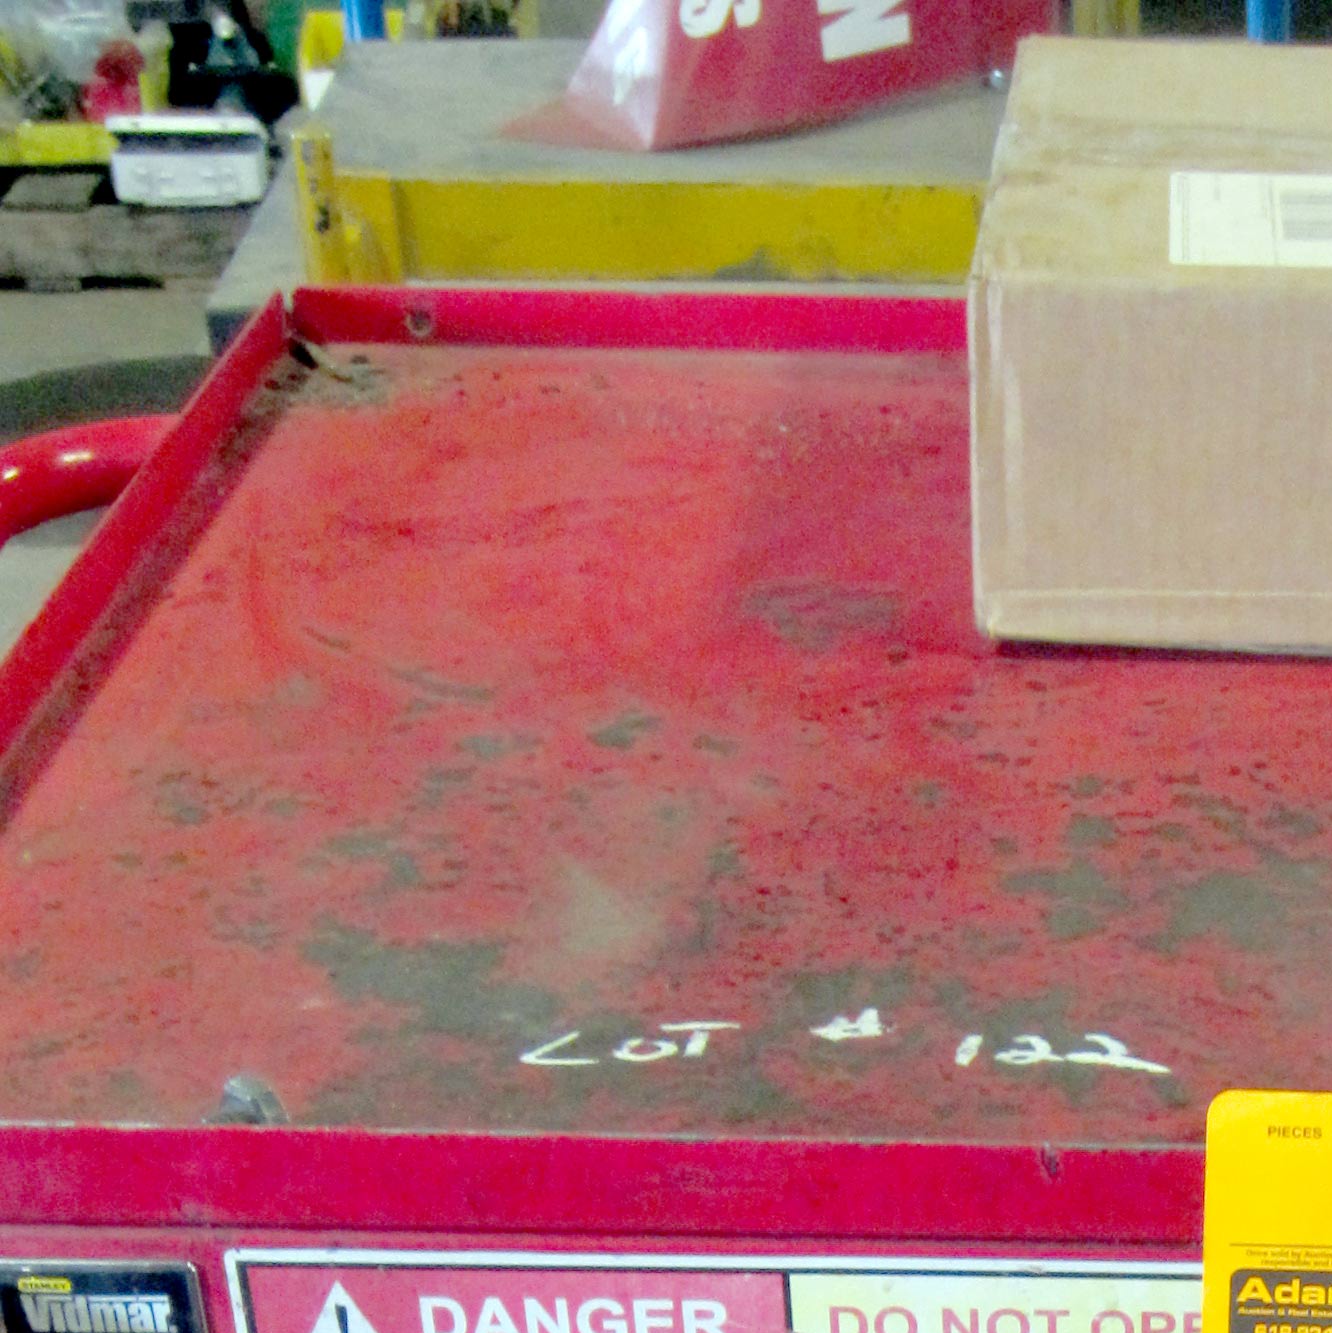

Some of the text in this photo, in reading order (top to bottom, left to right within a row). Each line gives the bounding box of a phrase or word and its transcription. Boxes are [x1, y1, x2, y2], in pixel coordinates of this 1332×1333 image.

[519, 1020, 741, 1066] LOT
[955, 1033, 1173, 1075] 122
[1267, 1126, 1323, 1140] PIECES
